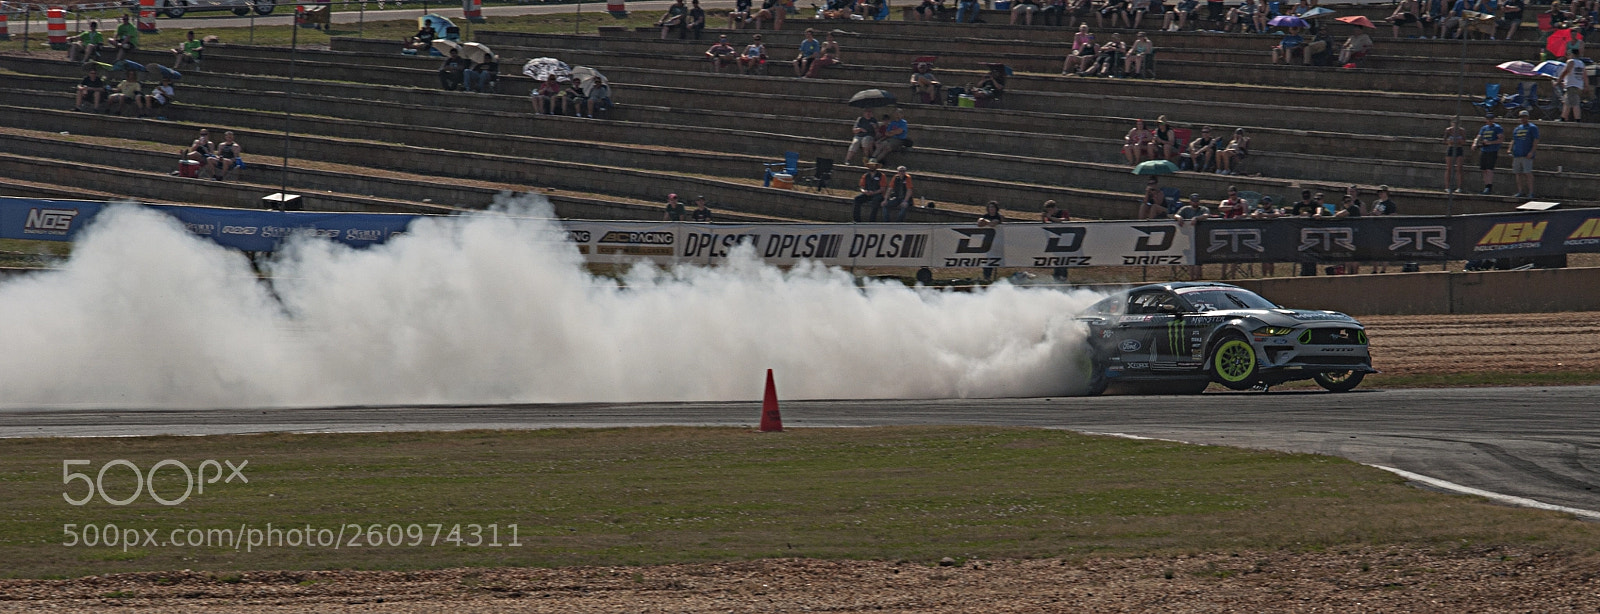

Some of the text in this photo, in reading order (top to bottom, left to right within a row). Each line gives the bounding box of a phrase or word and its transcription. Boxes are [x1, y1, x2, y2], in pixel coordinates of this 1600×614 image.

[24, 208, 79, 230] NOS
[629, 232, 674, 244] RACING
[1206, 228, 1265, 253] RTR
[1298, 227, 1356, 251] RTR
[1388, 225, 1450, 250] RTR
[1477, 221, 1548, 245] AEM
[764, 234, 818, 258] DPLS
[848, 234, 902, 258] DPLS
[944, 257, 1002, 267] DRIFZ
[1032, 256, 1092, 266] DRIFZ
[1121, 255, 1183, 265] DRIFZ
[1122, 341, 1138, 350] Ford
